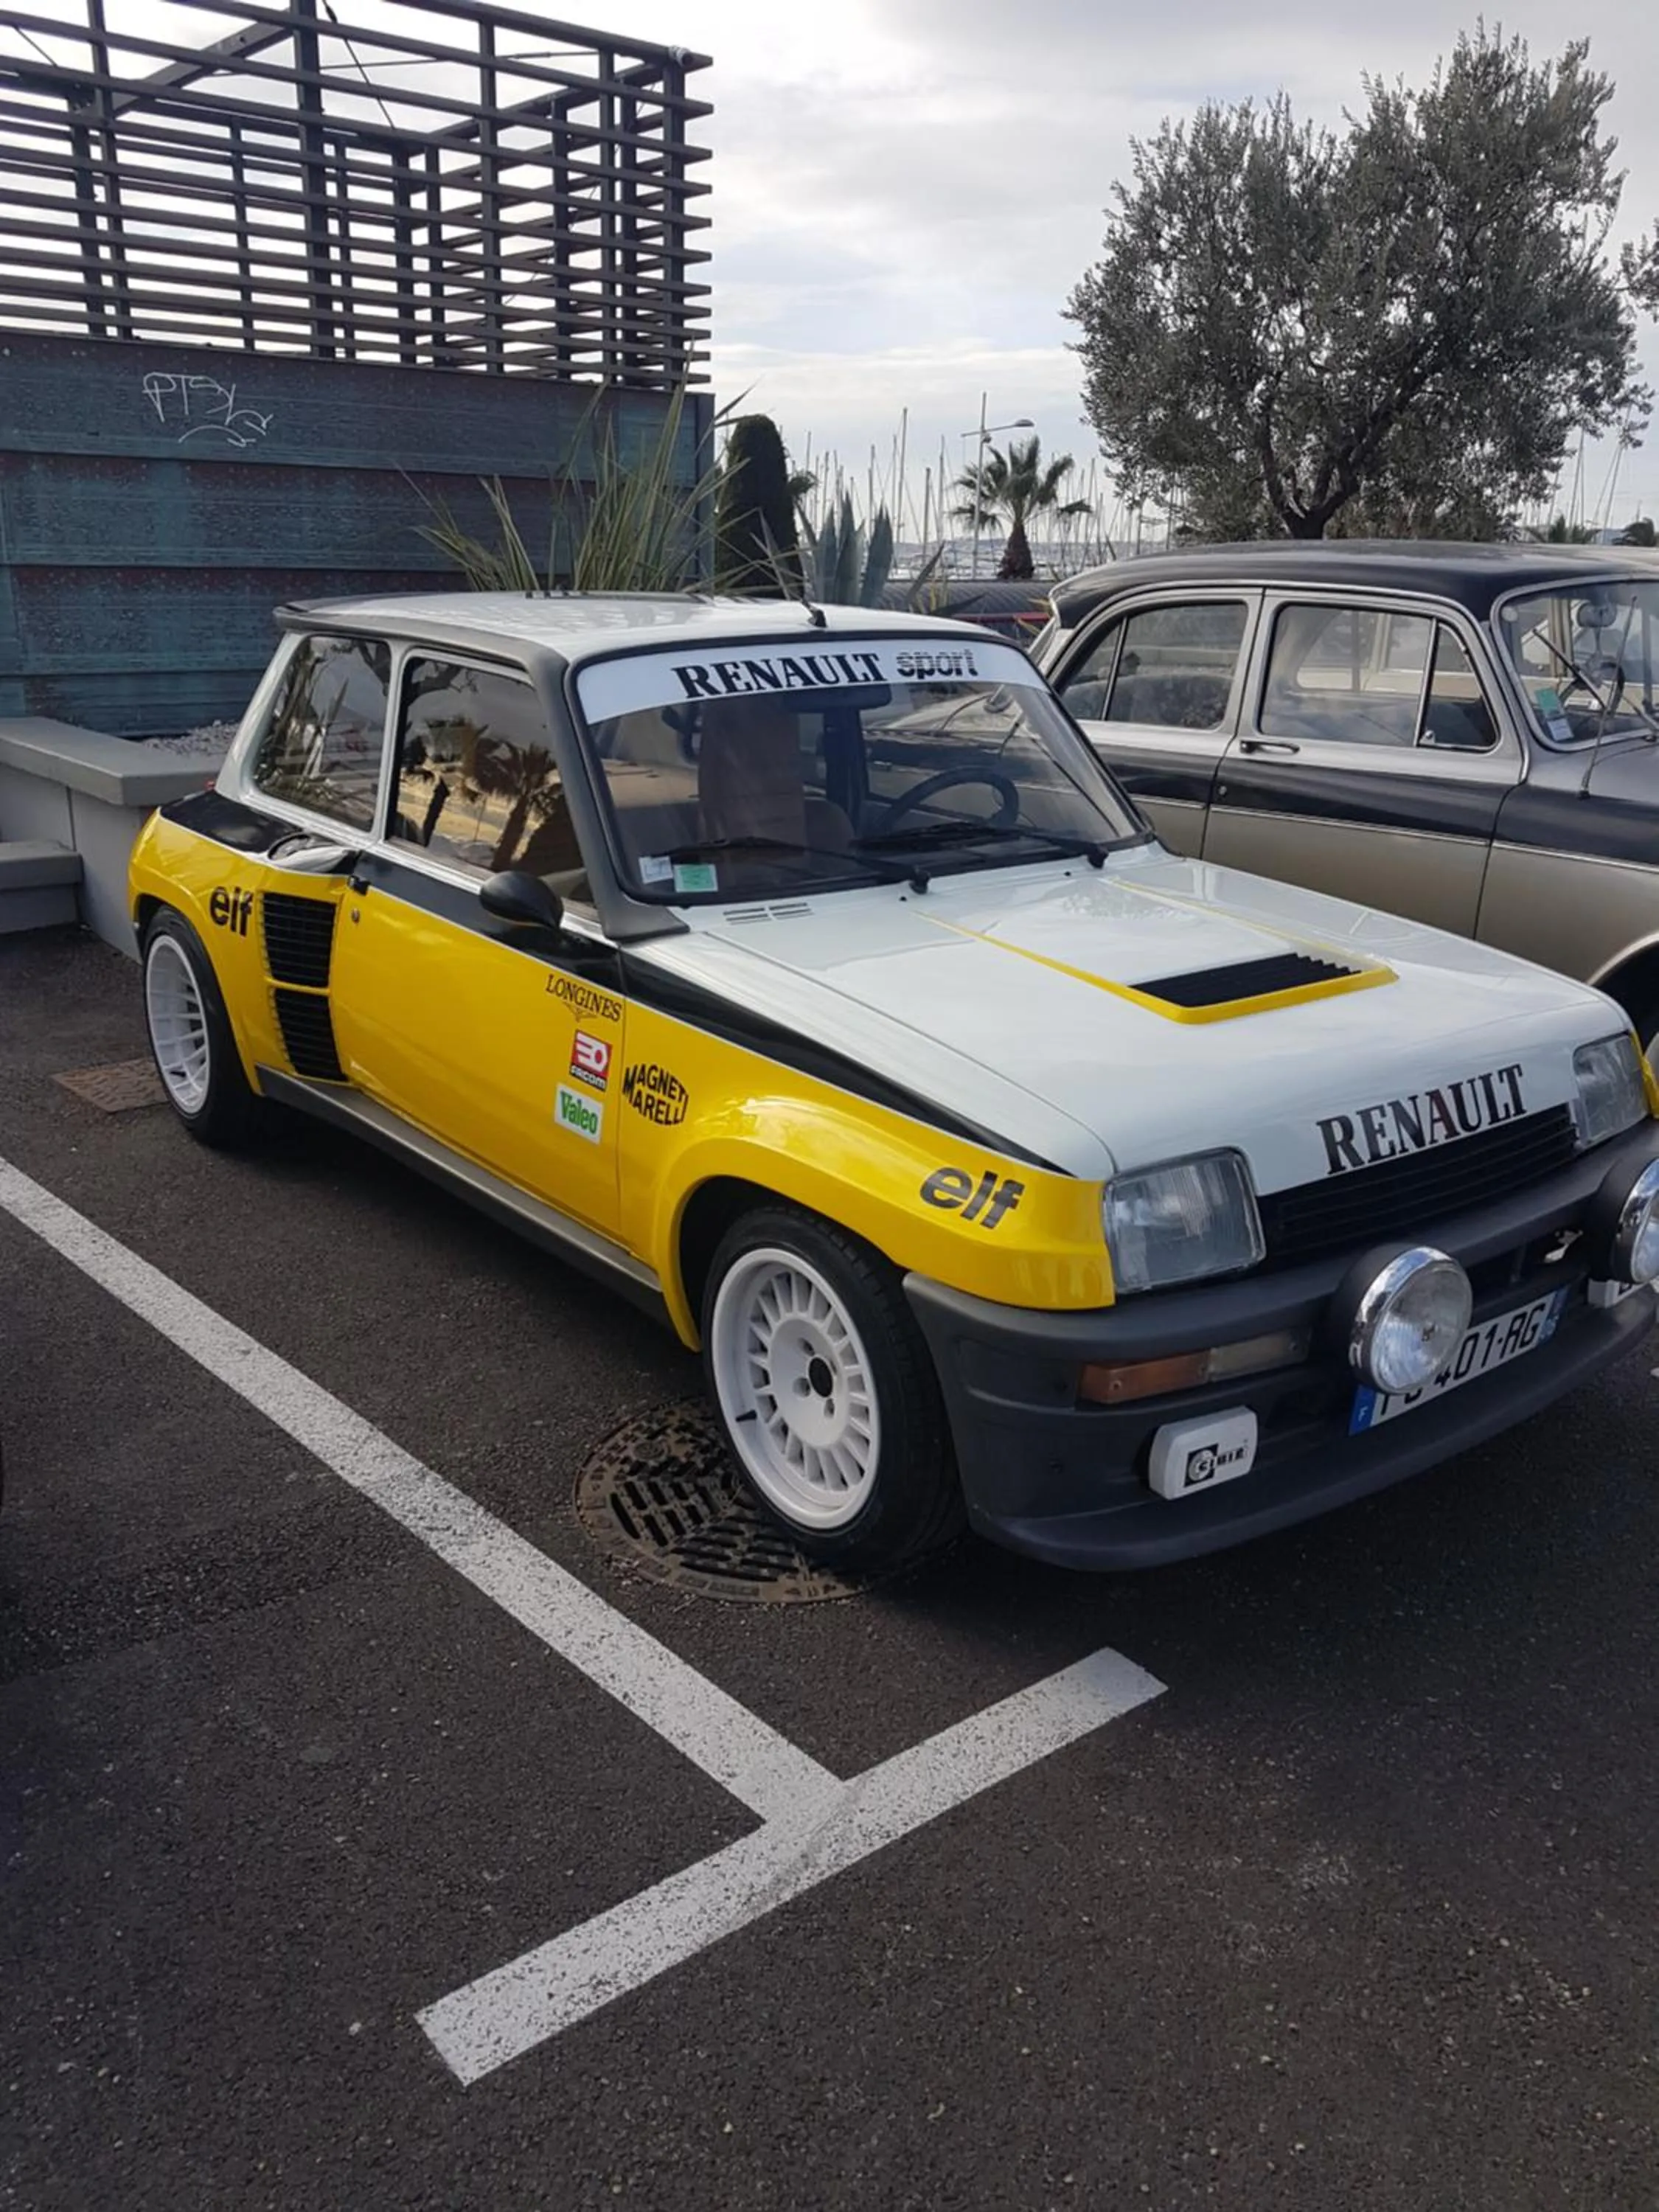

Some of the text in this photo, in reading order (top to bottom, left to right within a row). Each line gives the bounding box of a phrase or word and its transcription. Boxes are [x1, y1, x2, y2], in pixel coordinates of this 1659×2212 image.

[672, 649, 979, 699] RENAULT sport
[209, 886, 254, 937] elf
[546, 973, 622, 1022] LONGINES
[560, 1090, 599, 1135] Valeo
[1316, 1063, 1527, 1175] RENAULT
[919, 1166, 1026, 1230] elf
